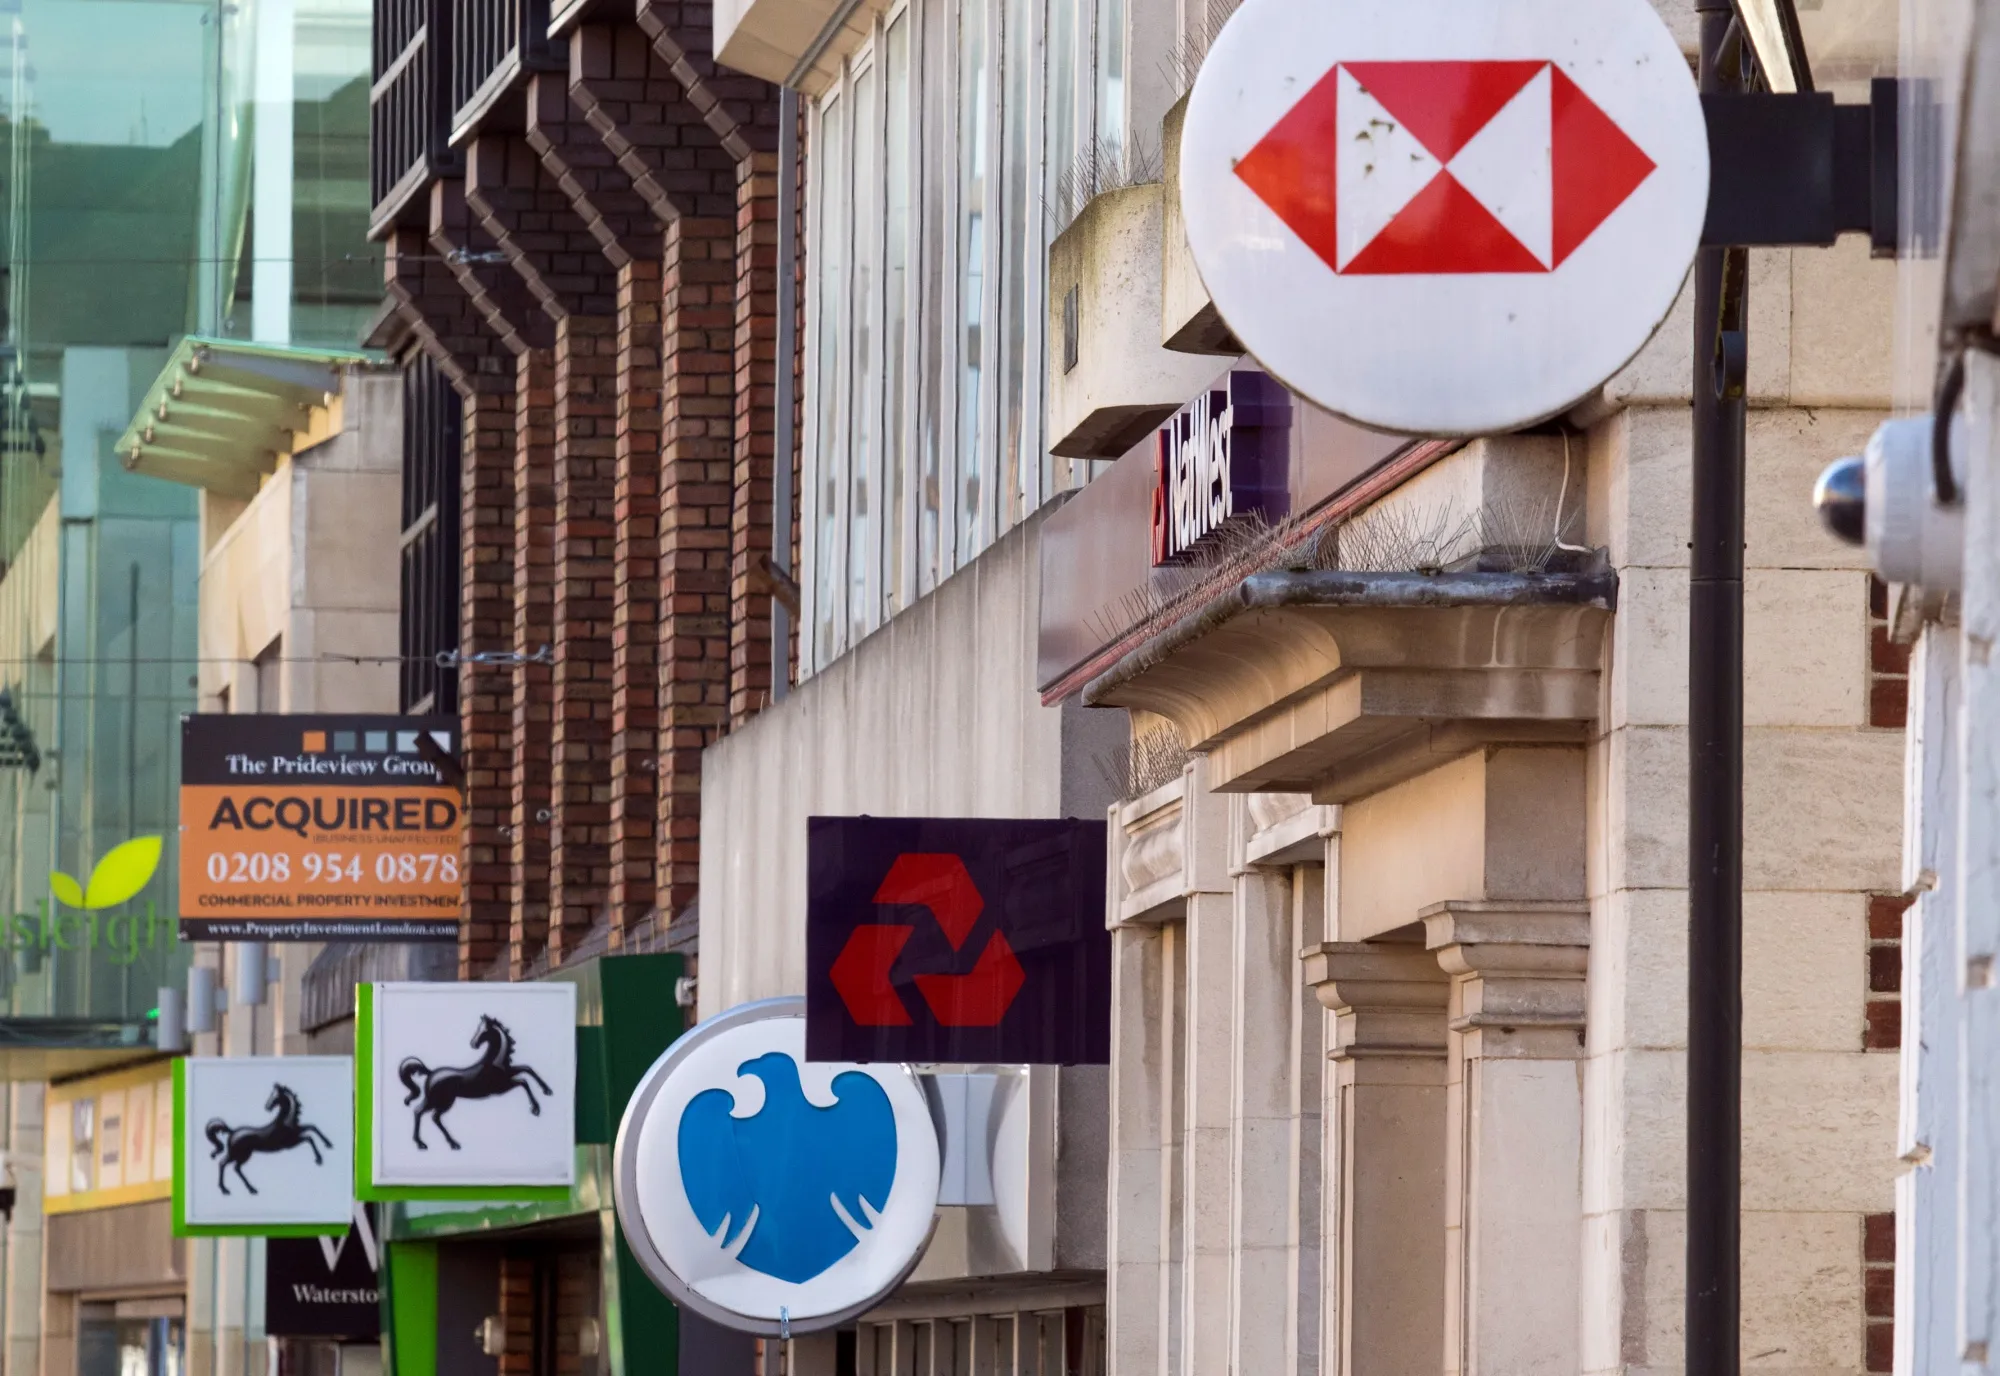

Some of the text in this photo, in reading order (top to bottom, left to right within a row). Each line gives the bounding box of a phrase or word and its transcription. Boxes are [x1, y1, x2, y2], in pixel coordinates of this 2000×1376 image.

[1169, 370, 1233, 557] NatWest
[225, 754, 443, 784] The Prideview Grou
[208, 796, 458, 838] ACQUIRED
[207, 852, 459, 884] 0208 954 0878
[198, 894, 291, 907] COMMERCIAL
[297, 894, 372, 907] PROPERTY
[0, 897, 177, 965] sleigh
[292, 1283, 379, 1304] Watersto
